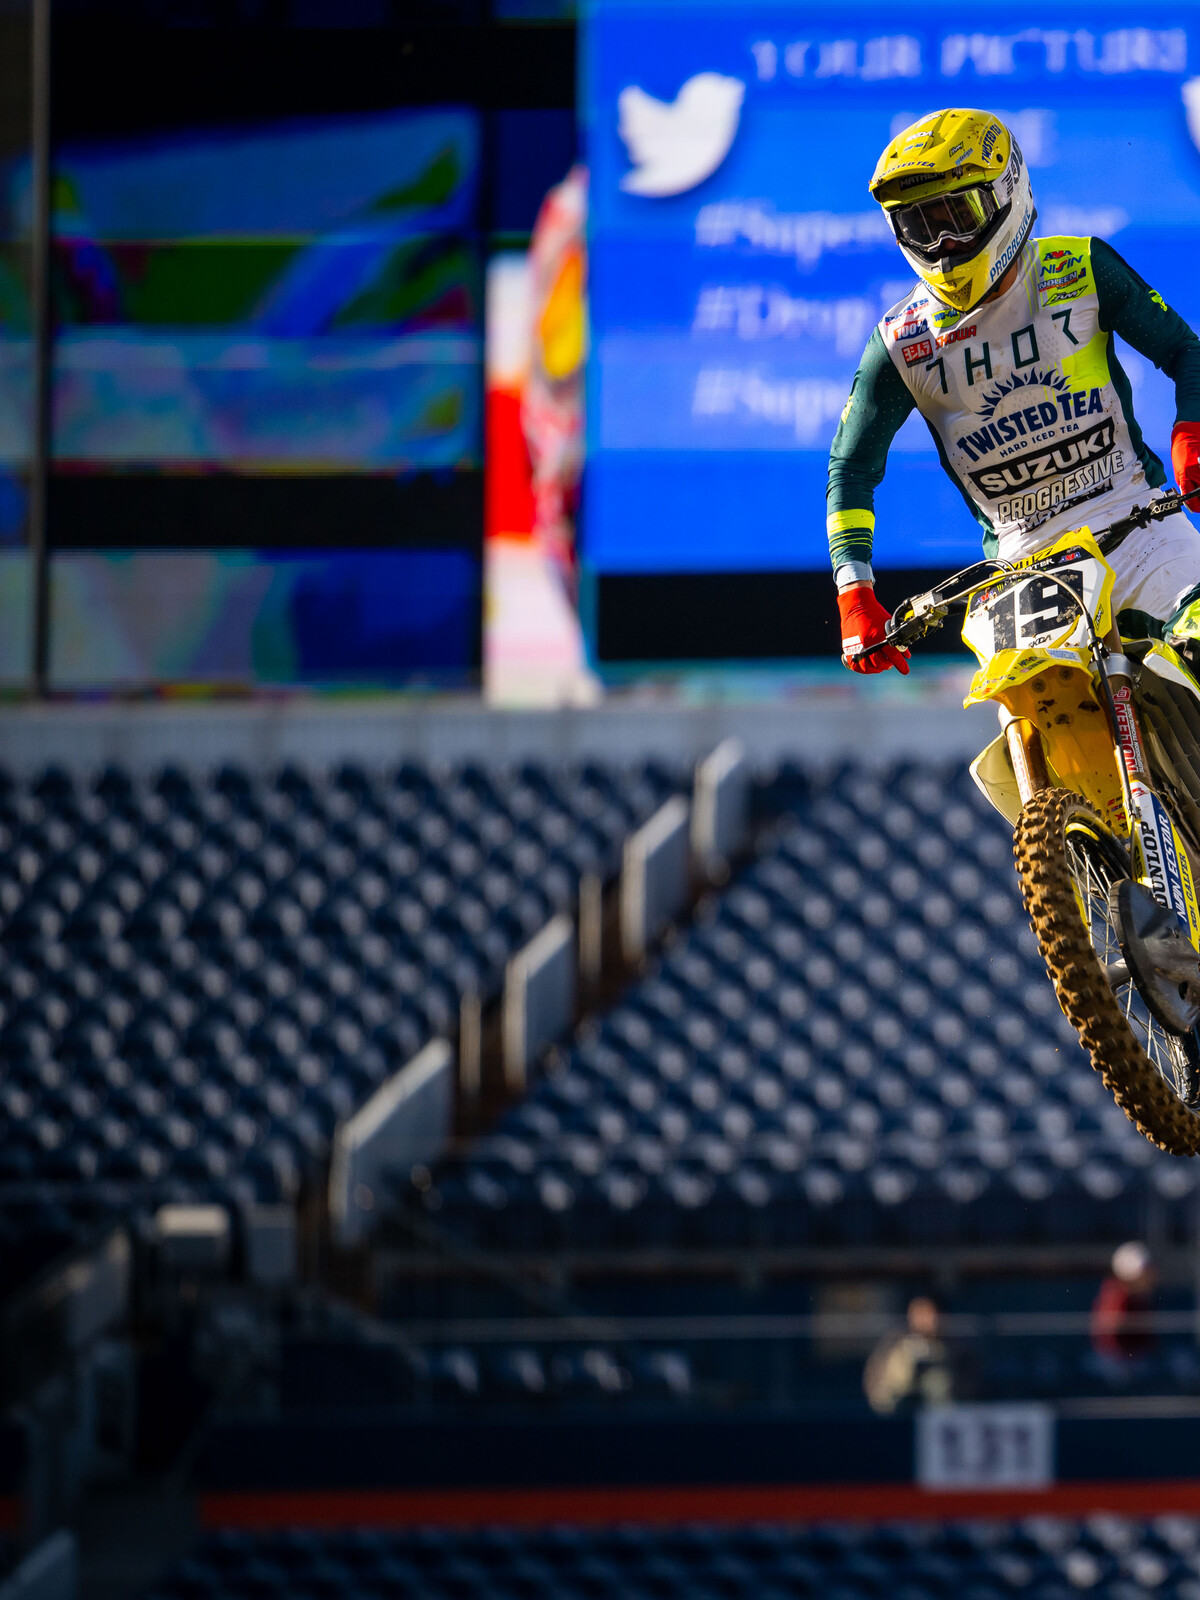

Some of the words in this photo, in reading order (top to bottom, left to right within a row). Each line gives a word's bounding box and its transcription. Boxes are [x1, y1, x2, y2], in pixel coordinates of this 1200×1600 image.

[896, 318, 927, 341] 100%
[936, 325, 977, 349] SHOWA
[956, 401, 1058, 463] TWISTED
[1056, 387, 1103, 421] TEA
[1000, 441, 1028, 458] HARD
[1032, 431, 1056, 444] ICED
[1060, 423, 1080, 434] TEA
[979, 426, 1111, 493] SUZUKI
[998, 450, 1125, 525] PROGRESSIVE
[1150, 500, 1179, 516] ARC
[988, 569, 1084, 654] 19
[1114, 702, 1138, 773] NOLEEN
[1141, 821, 1169, 908] DUNLOP
[1159, 814, 1180, 877] ECSTAR
